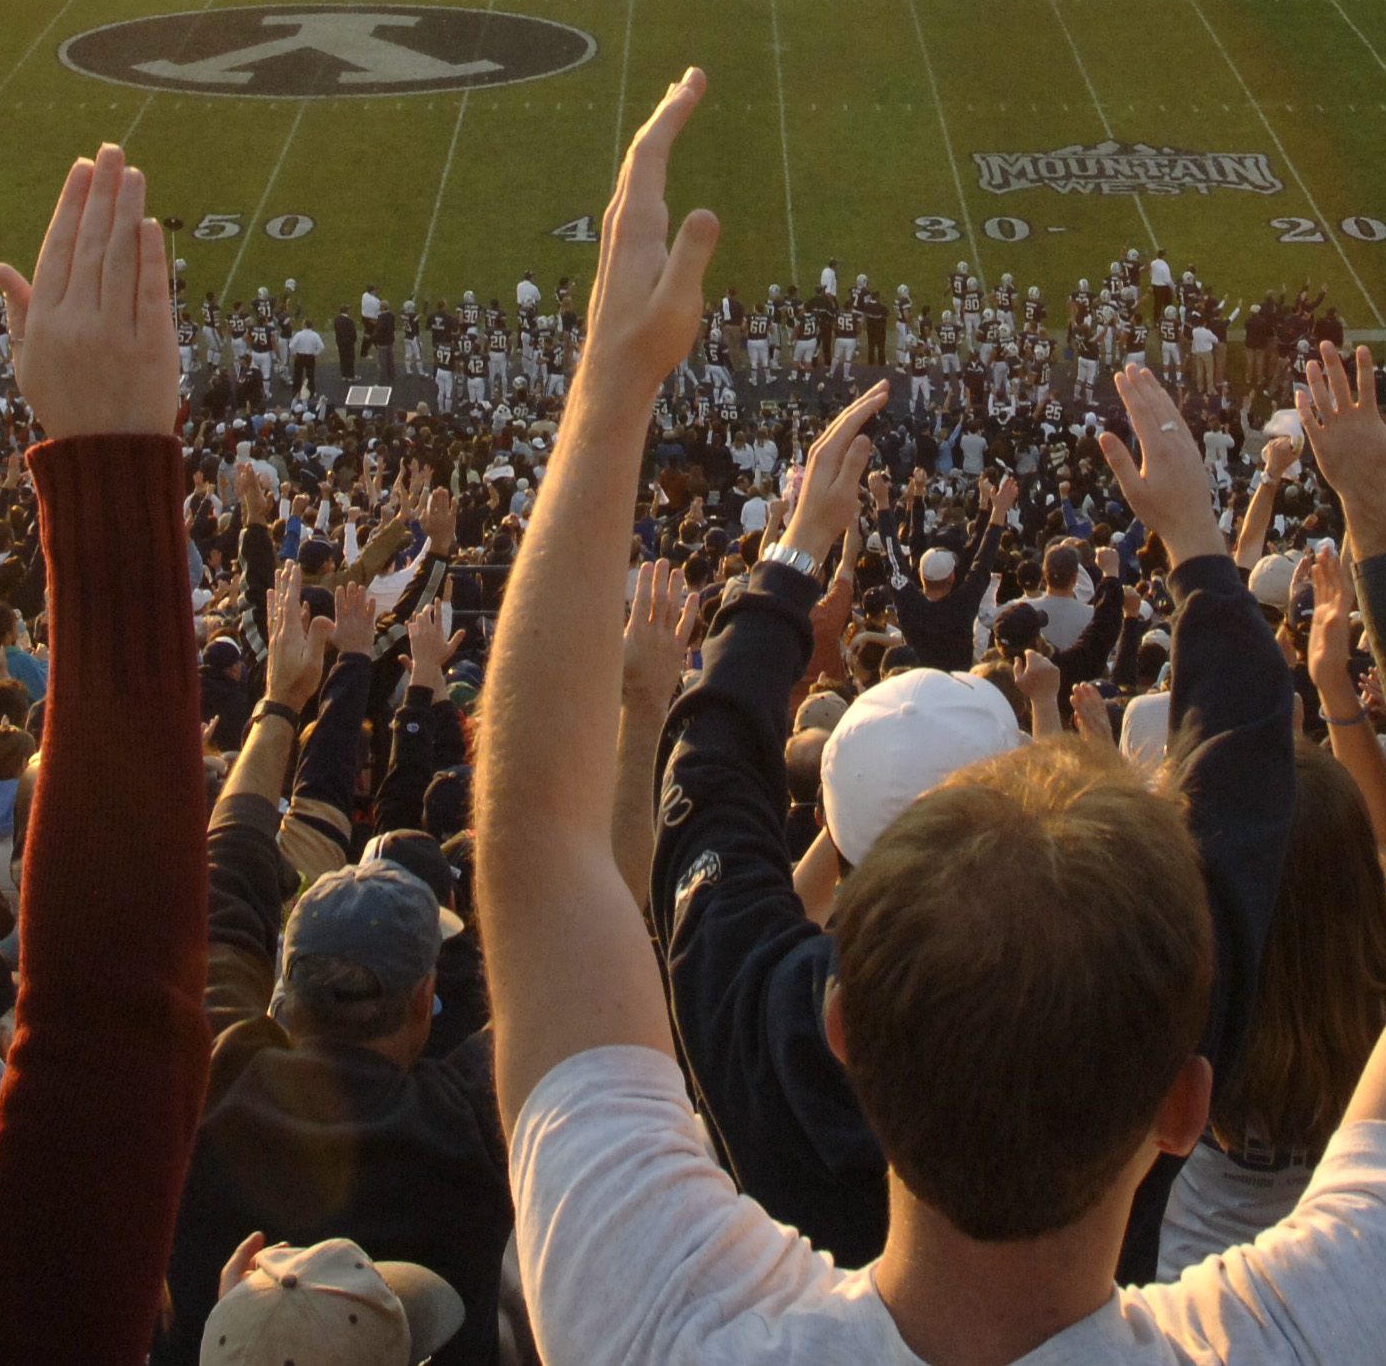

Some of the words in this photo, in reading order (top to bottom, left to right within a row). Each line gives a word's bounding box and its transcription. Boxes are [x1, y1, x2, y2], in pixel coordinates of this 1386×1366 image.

[131, 12, 504, 84] Y
[990, 152, 1268, 185] MOUNTAIN
[1045, 181, 1210, 195] WEST
[193, 214, 314, 240] 50
[913, 216, 1030, 242] 30
[464, 310, 478, 322] 30
[1025, 307, 1034, 320] 2
[228, 319, 245, 332] 22
[750, 321, 767, 334] 60
[838, 318, 854, 332] 95
[940, 331, 955, 344] 39
[1160, 327, 1175, 340] 55
[491, 335, 507, 349] 20
[437, 350, 452, 363] 97
[467, 360, 484, 374] 42
[1046, 404, 1063, 421] 25
